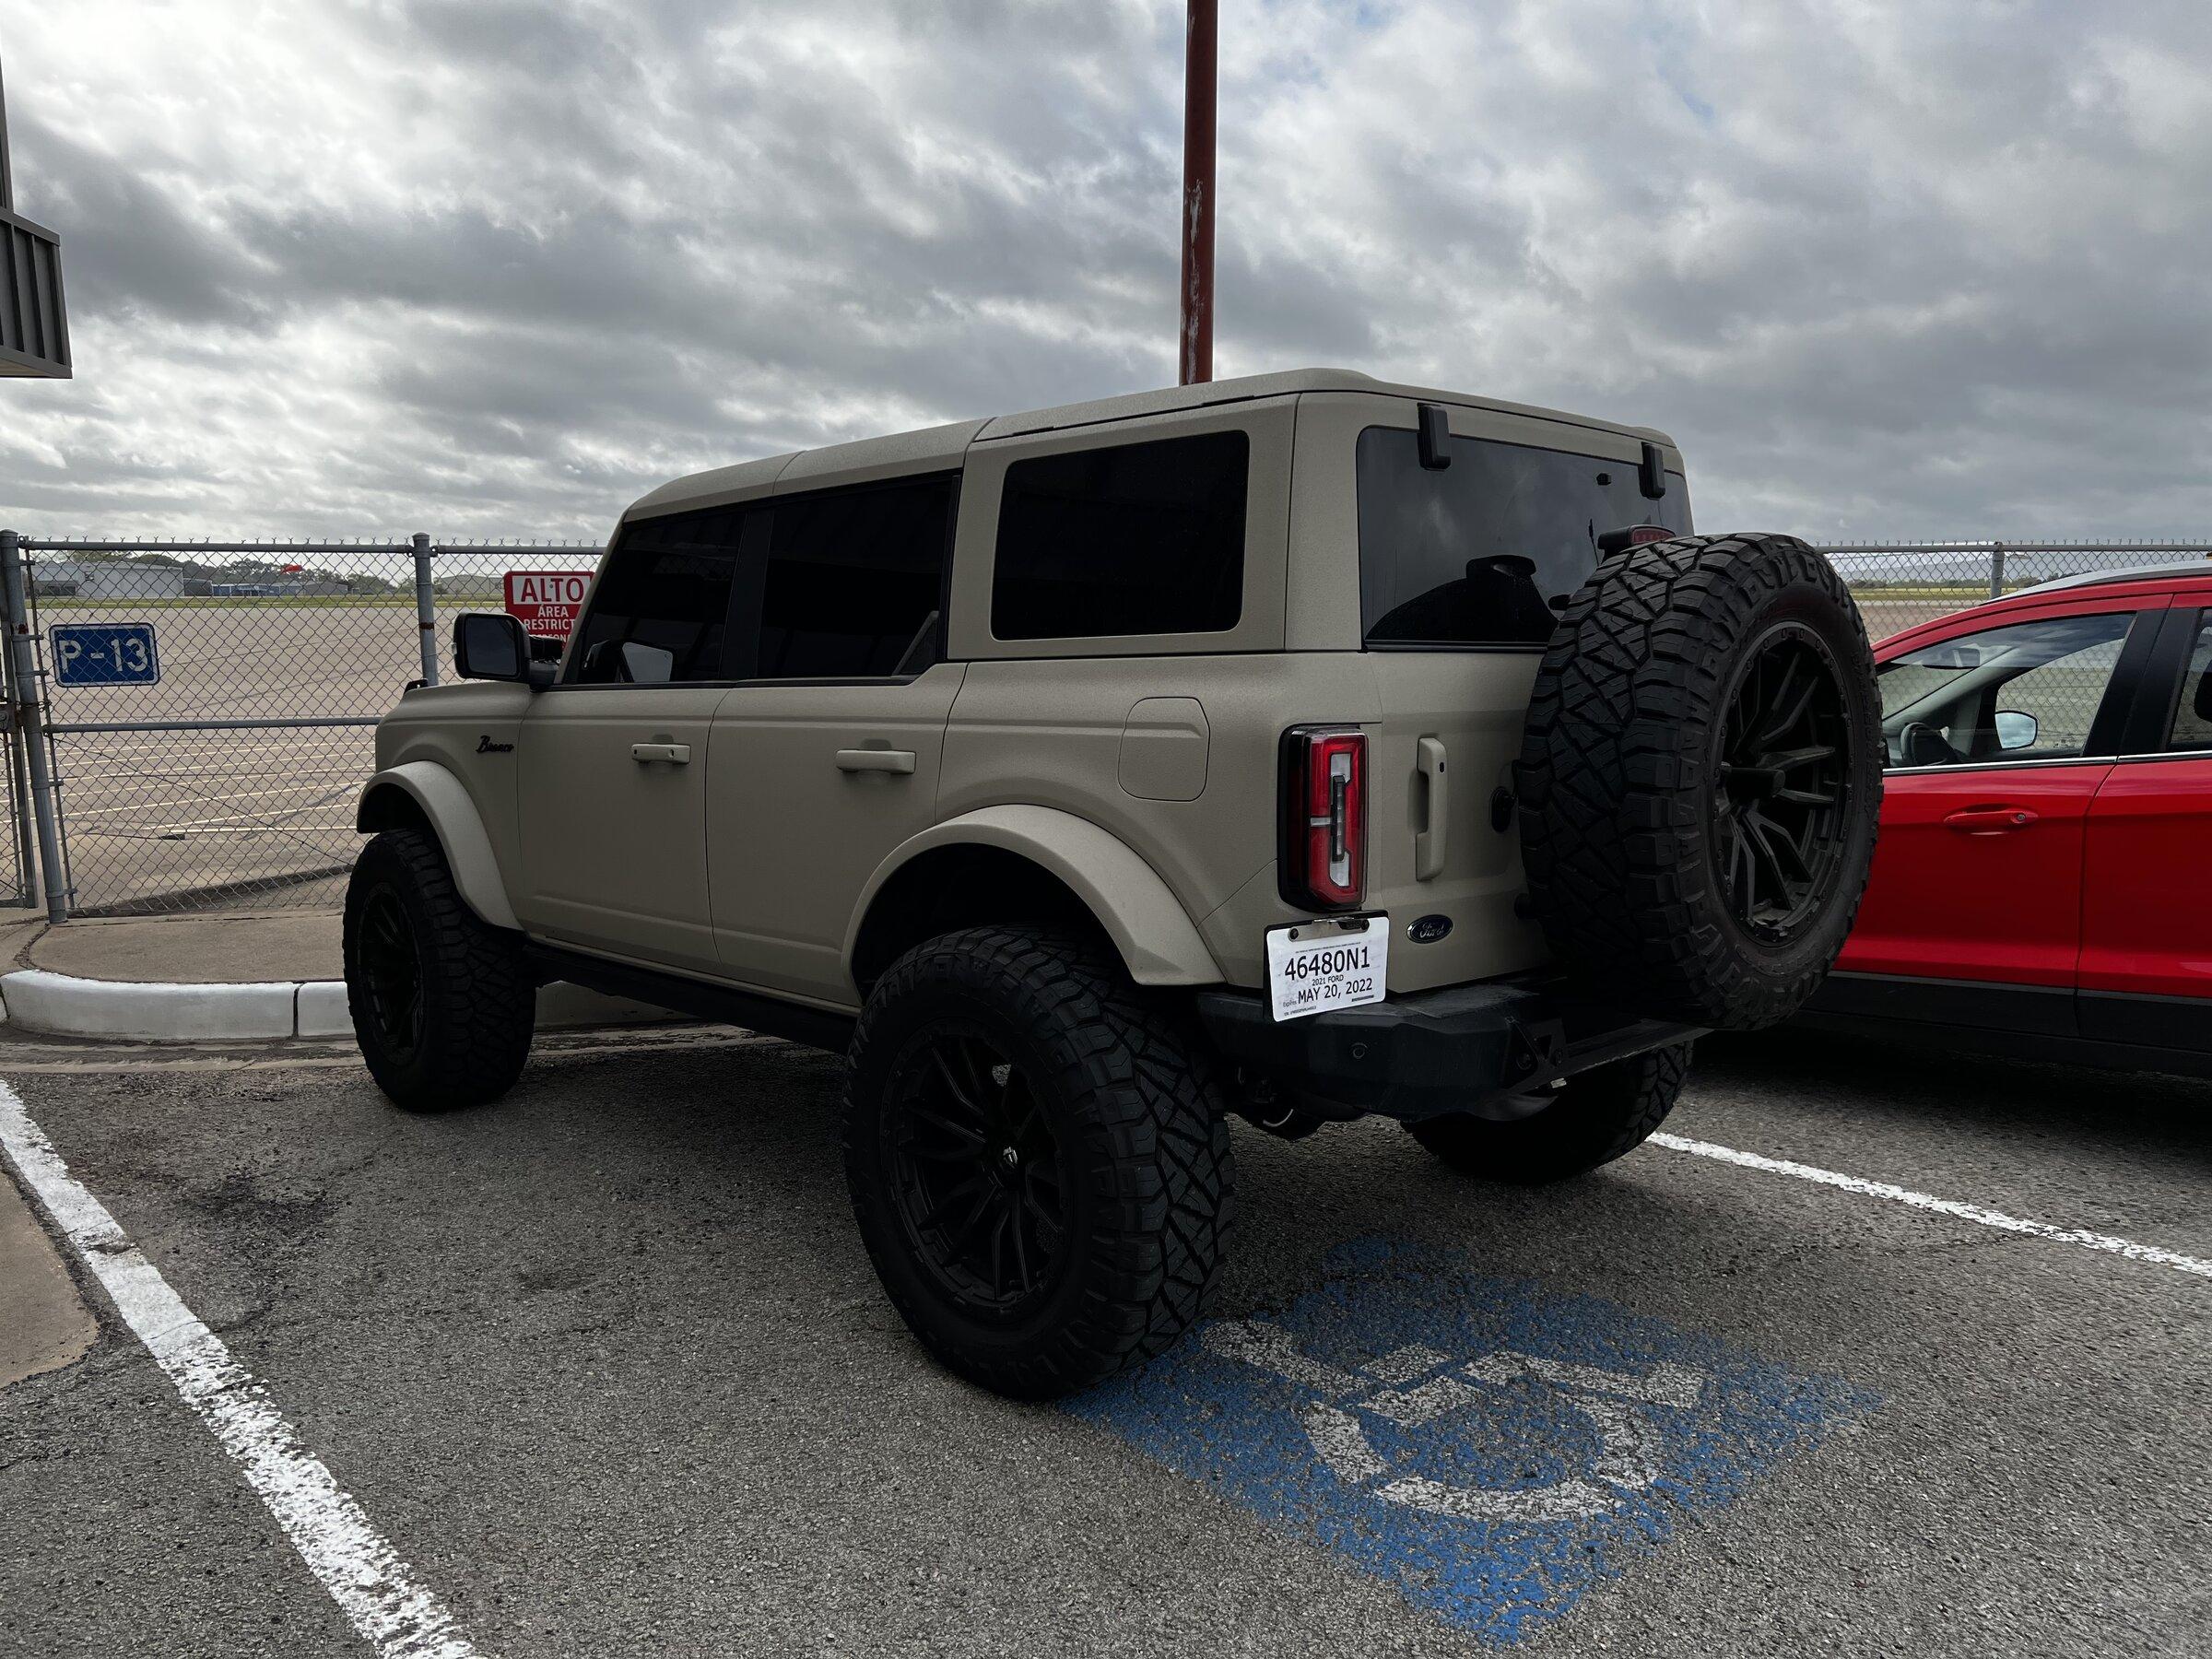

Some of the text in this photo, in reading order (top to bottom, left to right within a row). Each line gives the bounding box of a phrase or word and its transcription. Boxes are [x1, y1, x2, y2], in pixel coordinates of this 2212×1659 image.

[521, 578, 584, 602] ALTO
[537, 605, 569, 618] ÁREA
[58, 638, 148, 674] P-13
[476, 735, 515, 754] Bronco
[1418, 923, 1446, 938] Ford
[1285, 946, 1370, 981] 46480N1
[1298, 986, 1320, 1004] MAY
[1324, 983, 1341, 999] 20,
[1346, 977, 1372, 994] 2022
[1312, 974, 1344, 986] 2021 FORD
